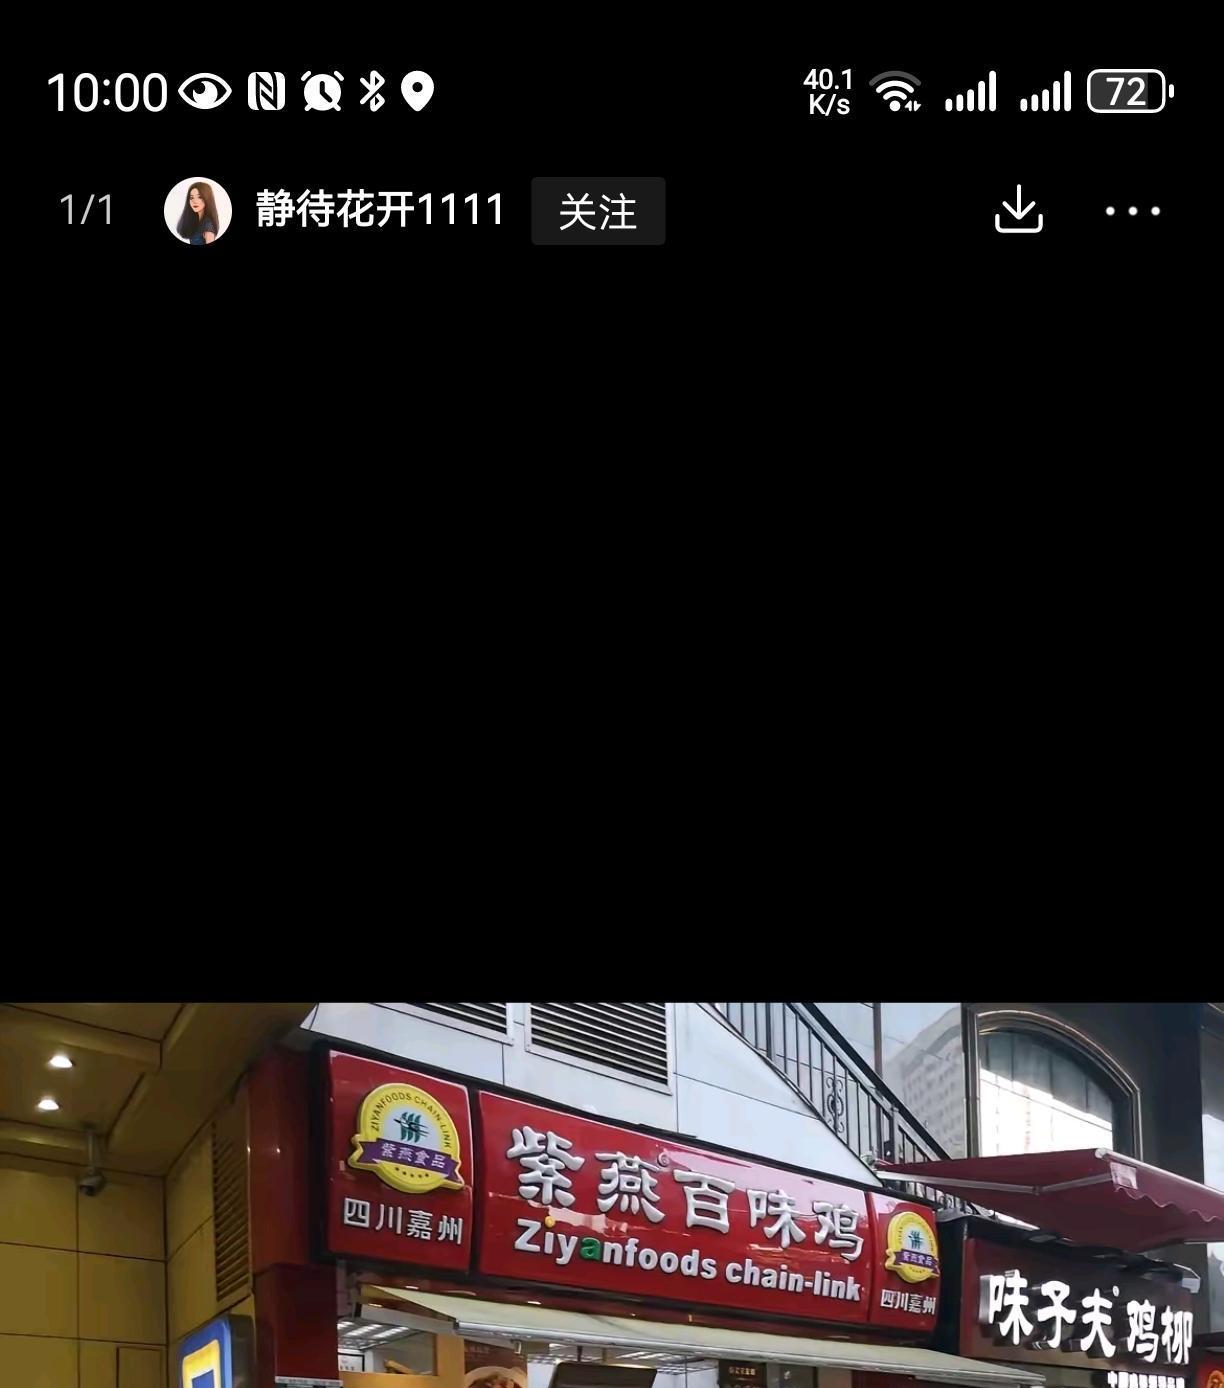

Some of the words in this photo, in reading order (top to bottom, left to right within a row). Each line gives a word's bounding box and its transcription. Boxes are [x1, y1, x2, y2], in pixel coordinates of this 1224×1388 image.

[343, 1197, 464, 1246] 四川嘉州
[506, 1125, 865, 1262] 紫燕百味鸡
[514, 1215, 718, 1282] Ziyanfoods
[725, 1258, 861, 1302] chain-link
[880, 1288, 937, 1316] 四川嘉州
